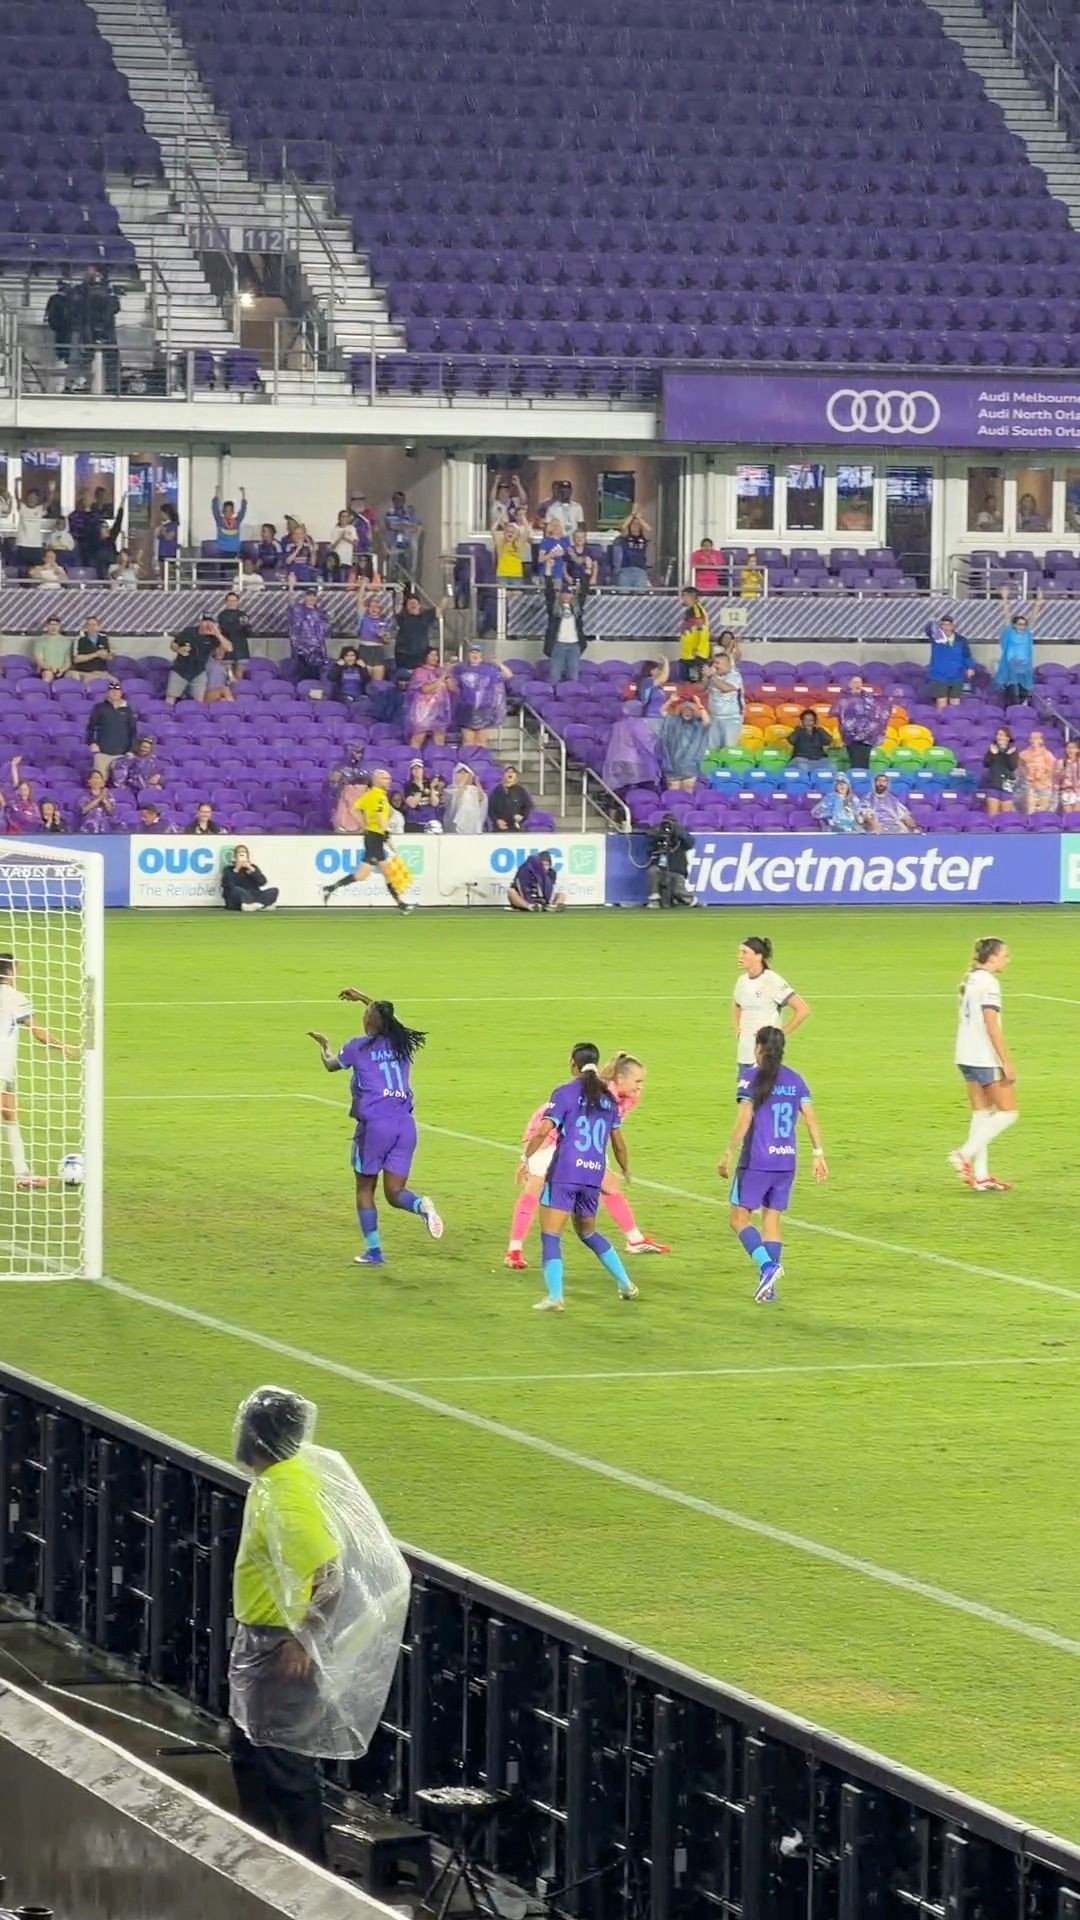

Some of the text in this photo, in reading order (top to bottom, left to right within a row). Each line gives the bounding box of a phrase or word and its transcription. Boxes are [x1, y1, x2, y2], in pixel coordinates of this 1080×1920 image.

[245, 230, 282, 251] 112
[978, 391, 1010, 402] Audi
[978, 408, 1010, 419] Audi
[1013, 409, 1053, 420] North
[977, 425, 1010, 436] Audi
[1011, 426, 1053, 437] South
[138, 847, 214, 874] OUC
[315, 848, 390, 874] OU
[685, 842, 993, 892] ticketmaster
[139, 883, 217, 897] The Reliable
[379, 1061, 404, 1092] 11
[771, 1102, 793, 1139] 13
[574, 1115, 607, 1155] 30
